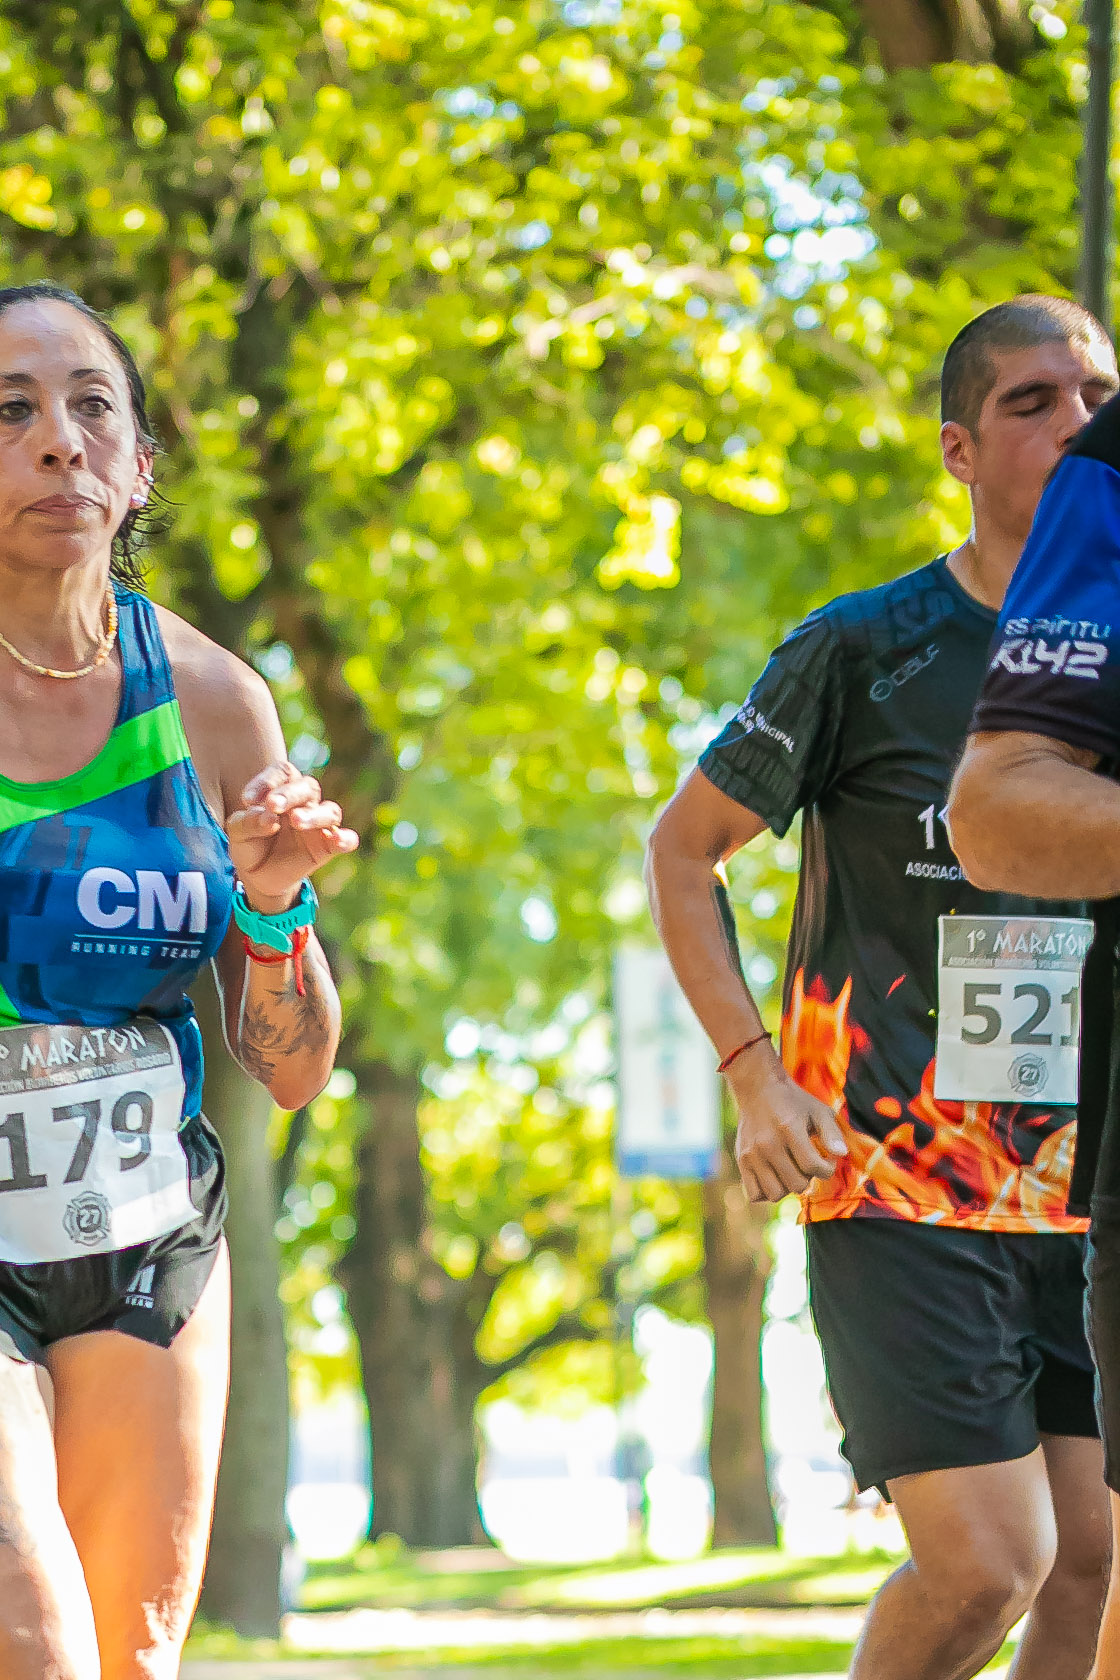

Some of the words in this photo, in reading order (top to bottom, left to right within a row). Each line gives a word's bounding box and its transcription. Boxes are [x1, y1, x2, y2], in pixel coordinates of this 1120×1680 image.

[905, 861, 966, 880] ASOCIACI
[77, 866, 208, 934] CM
[70, 941, 151, 956] RUNNING
[160, 946, 201, 959] TEAM
[992, 926, 1087, 955] MARATÓN
